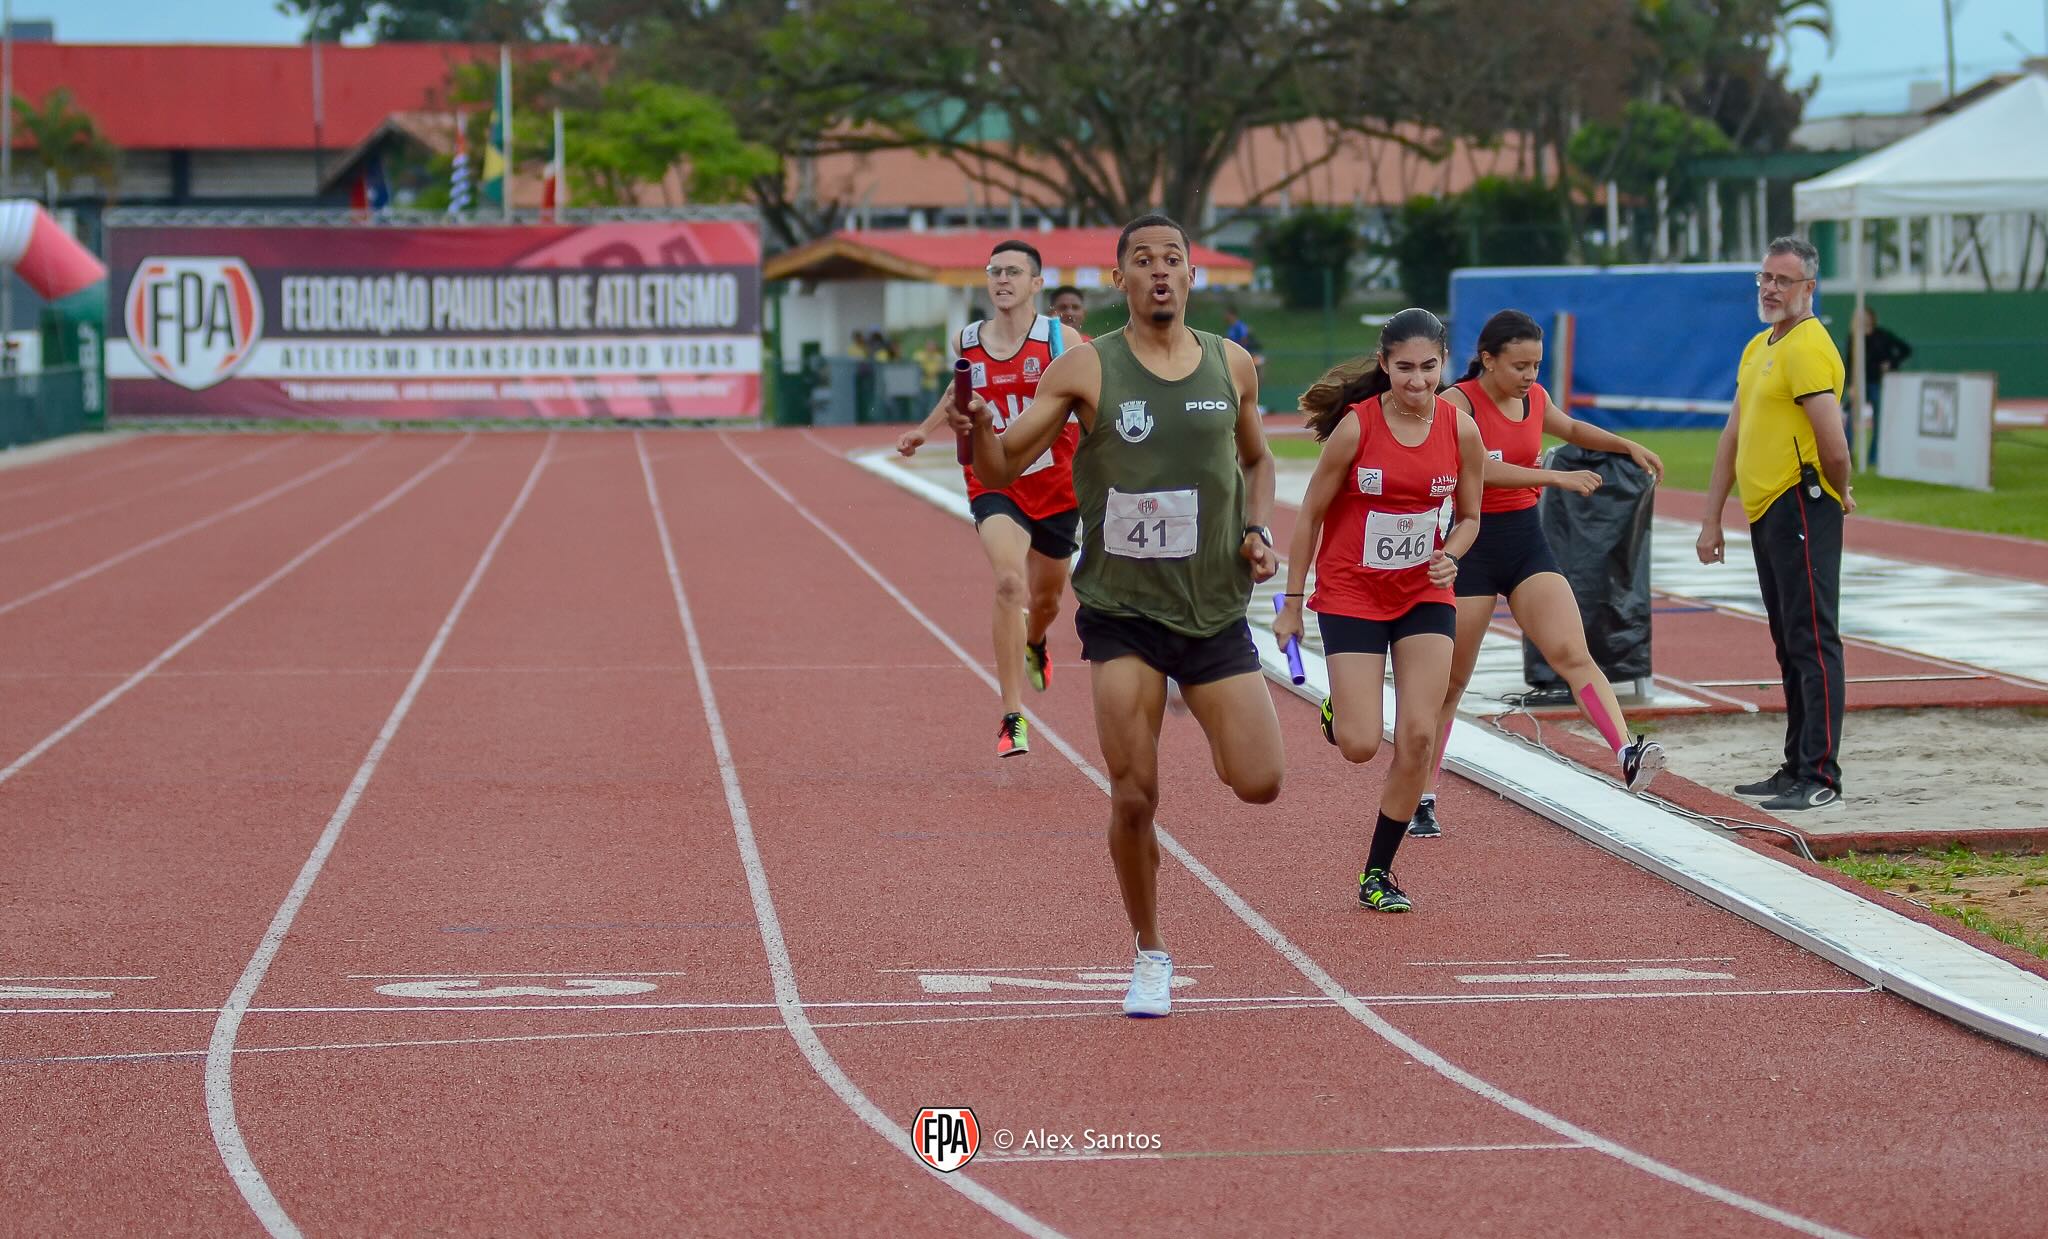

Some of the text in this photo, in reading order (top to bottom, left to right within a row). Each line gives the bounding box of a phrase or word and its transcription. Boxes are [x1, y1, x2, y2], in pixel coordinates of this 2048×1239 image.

[281, 272, 738, 335] FEDERAÇÃO PAULISTA DE ATLETISMO
[153, 271, 235, 367] FPA
[281, 344, 735, 369] ATLETISMO TRANSFORMANDO VIDAS
[1186, 401, 1227, 411] PICO
[1127, 520, 1167, 548] 41
[1377, 534, 1426, 560] 646
